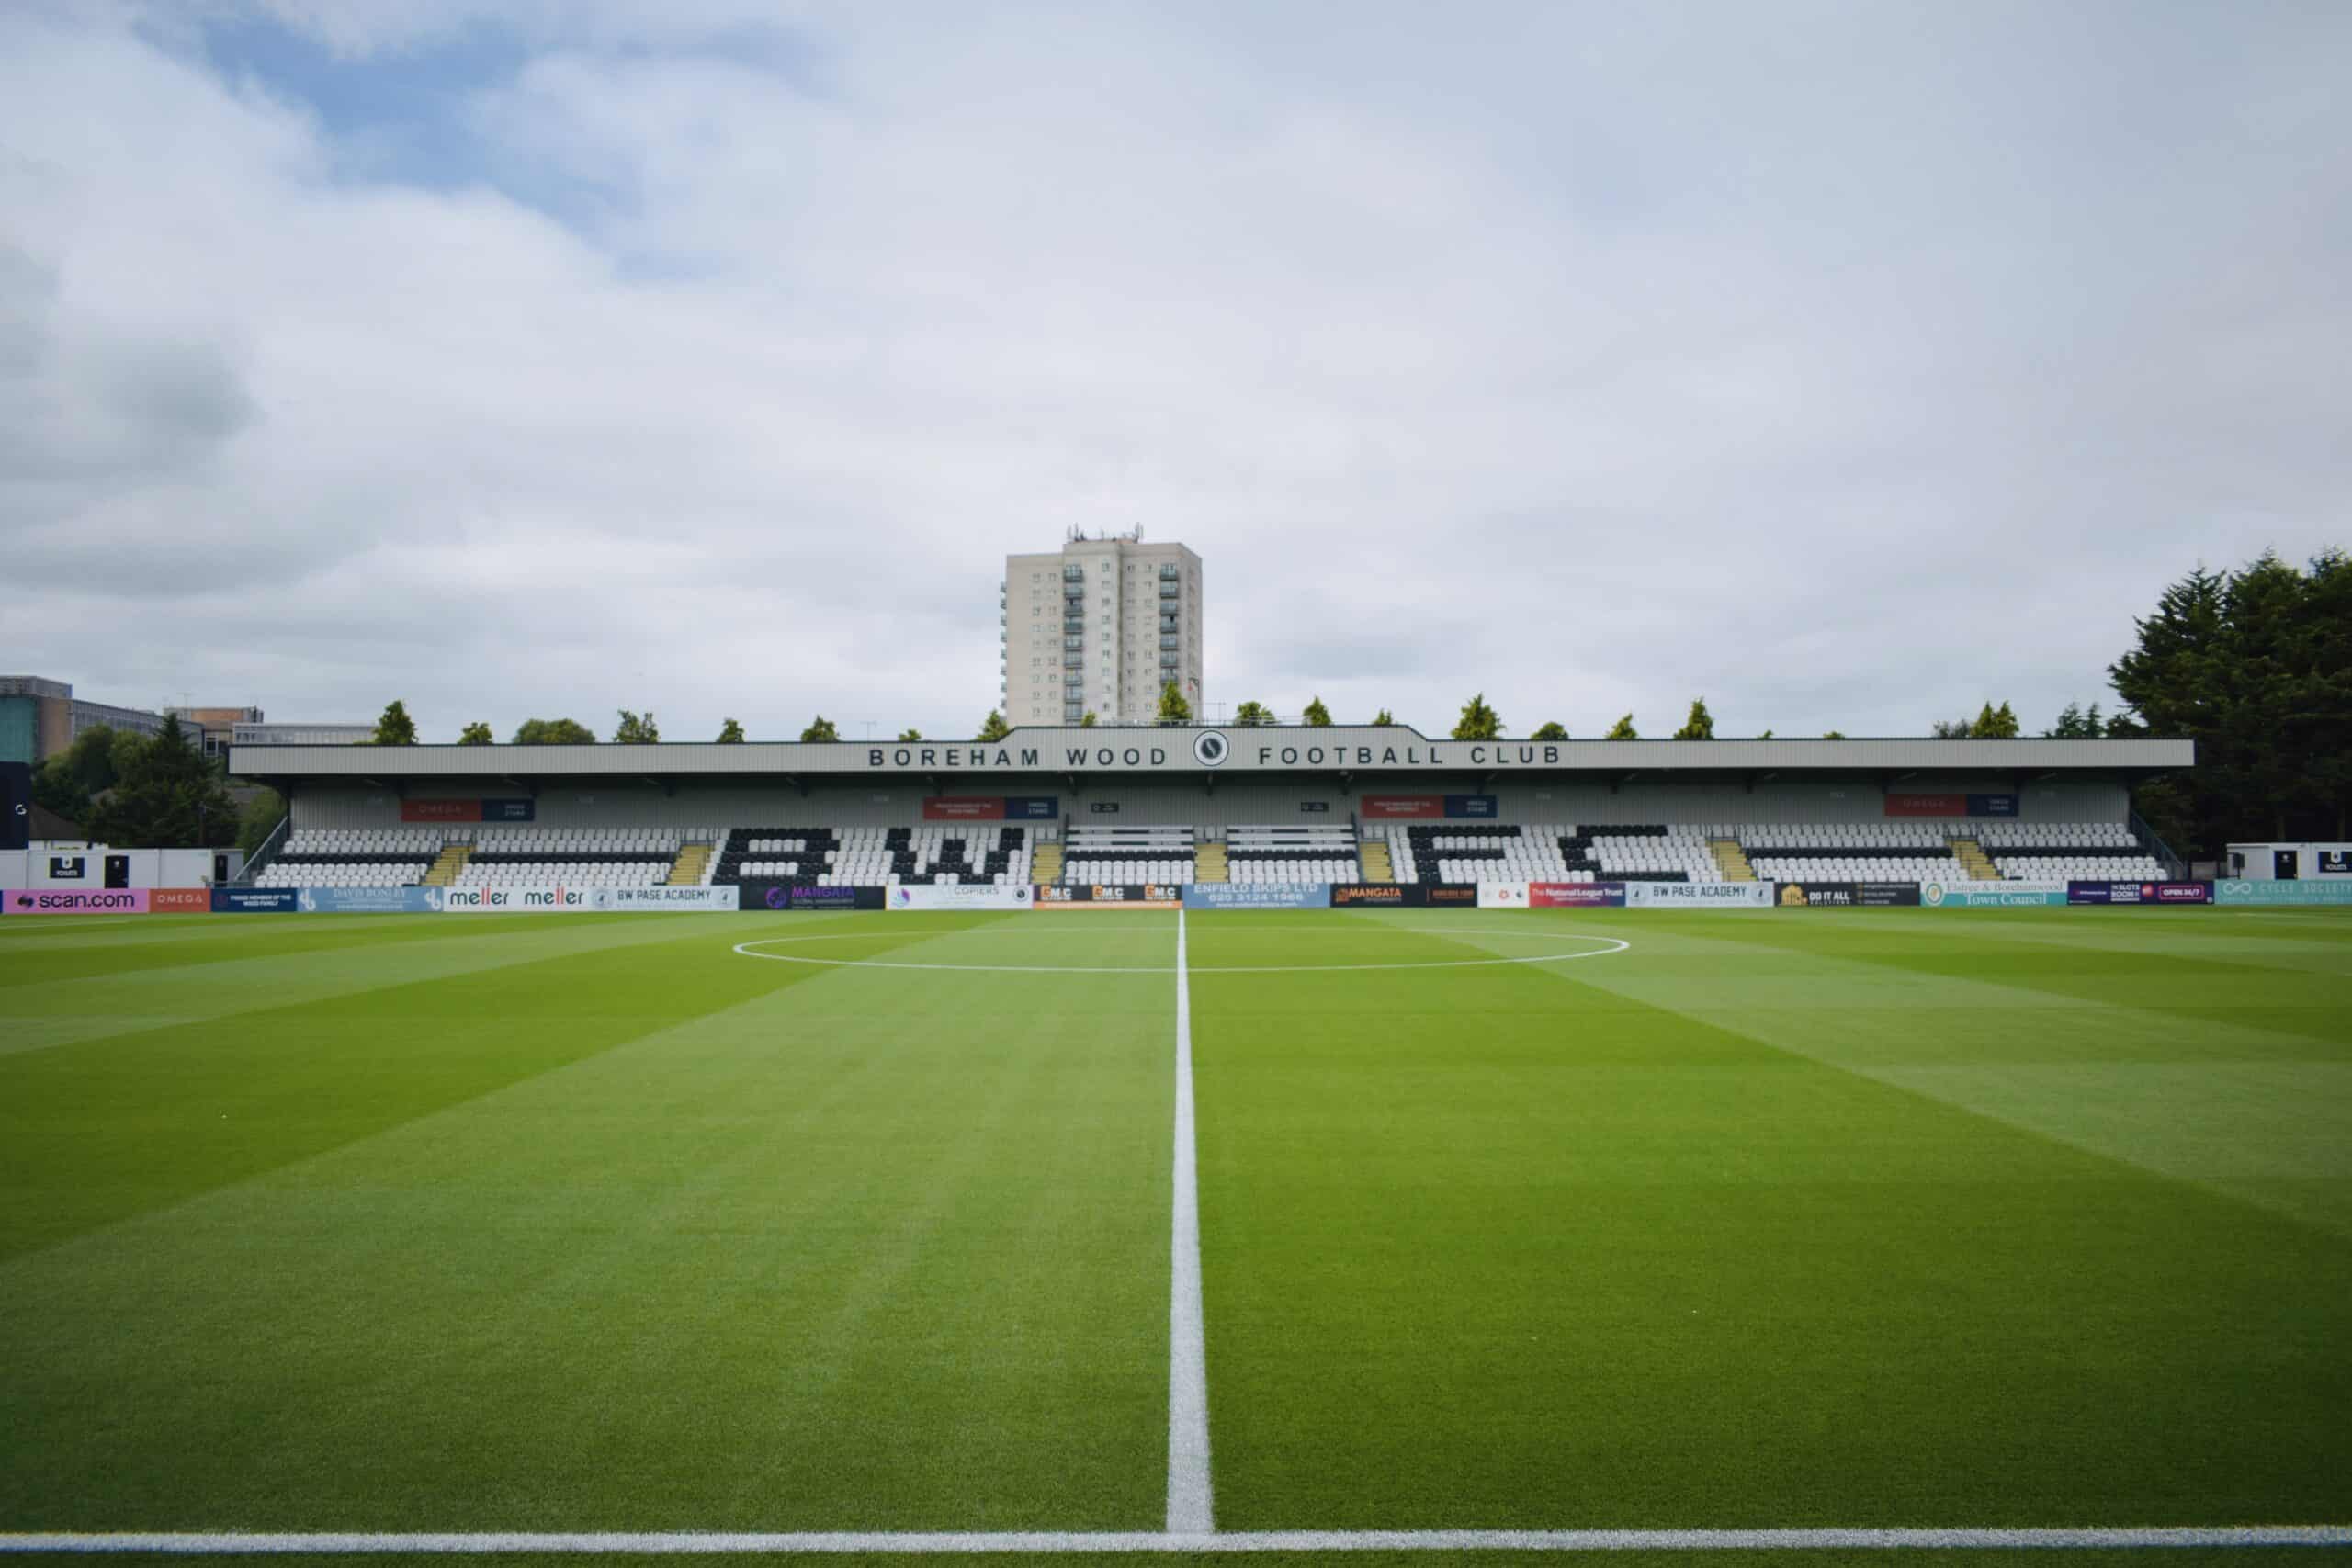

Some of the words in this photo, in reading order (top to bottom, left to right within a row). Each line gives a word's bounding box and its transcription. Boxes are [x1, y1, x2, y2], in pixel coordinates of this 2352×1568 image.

[869, 749, 1039, 766] BOREHAM
[1066, 749, 1166, 766] WOOD
[1259, 747, 1442, 764] FOOTBALL
[1470, 746, 1559, 764] CLUB
[792, 886, 856, 897] MANGATA
[955, 886, 1000, 896] COPIERS
[1193, 882, 1250, 893] ENFIELD
[1252, 882, 1291, 893] SKIPS
[1294, 881, 1318, 893] LTD
[1349, 888, 1402, 897] MANGATA
[1545, 888, 1577, 897] National
[1577, 888, 1603, 897] League
[1604, 888, 1623, 897] Trust
[1653, 886, 1668, 897] BW
[1672, 886, 1698, 897] PASE
[1700, 886, 1747, 897] ACADEMY
[2163, 888, 2183, 897] OPEN
[156, 895, 203, 903] OMEGA
[449, 887, 509, 906] meller
[525, 886, 584, 905] meller
[617, 889, 633, 901] BW
[637, 889, 662, 901] PASE
[665, 889, 711, 901] ACADEMY
[1208, 894, 1233, 902] 020
[1808, 892, 1822, 901] DO
[1823, 892, 1831, 901] IT
[1833, 892, 1850, 901] ALL
[1966, 892, 1998, 905] Town
[2001, 892, 2047, 905] Council
[40, 894, 135, 908] scan.com
